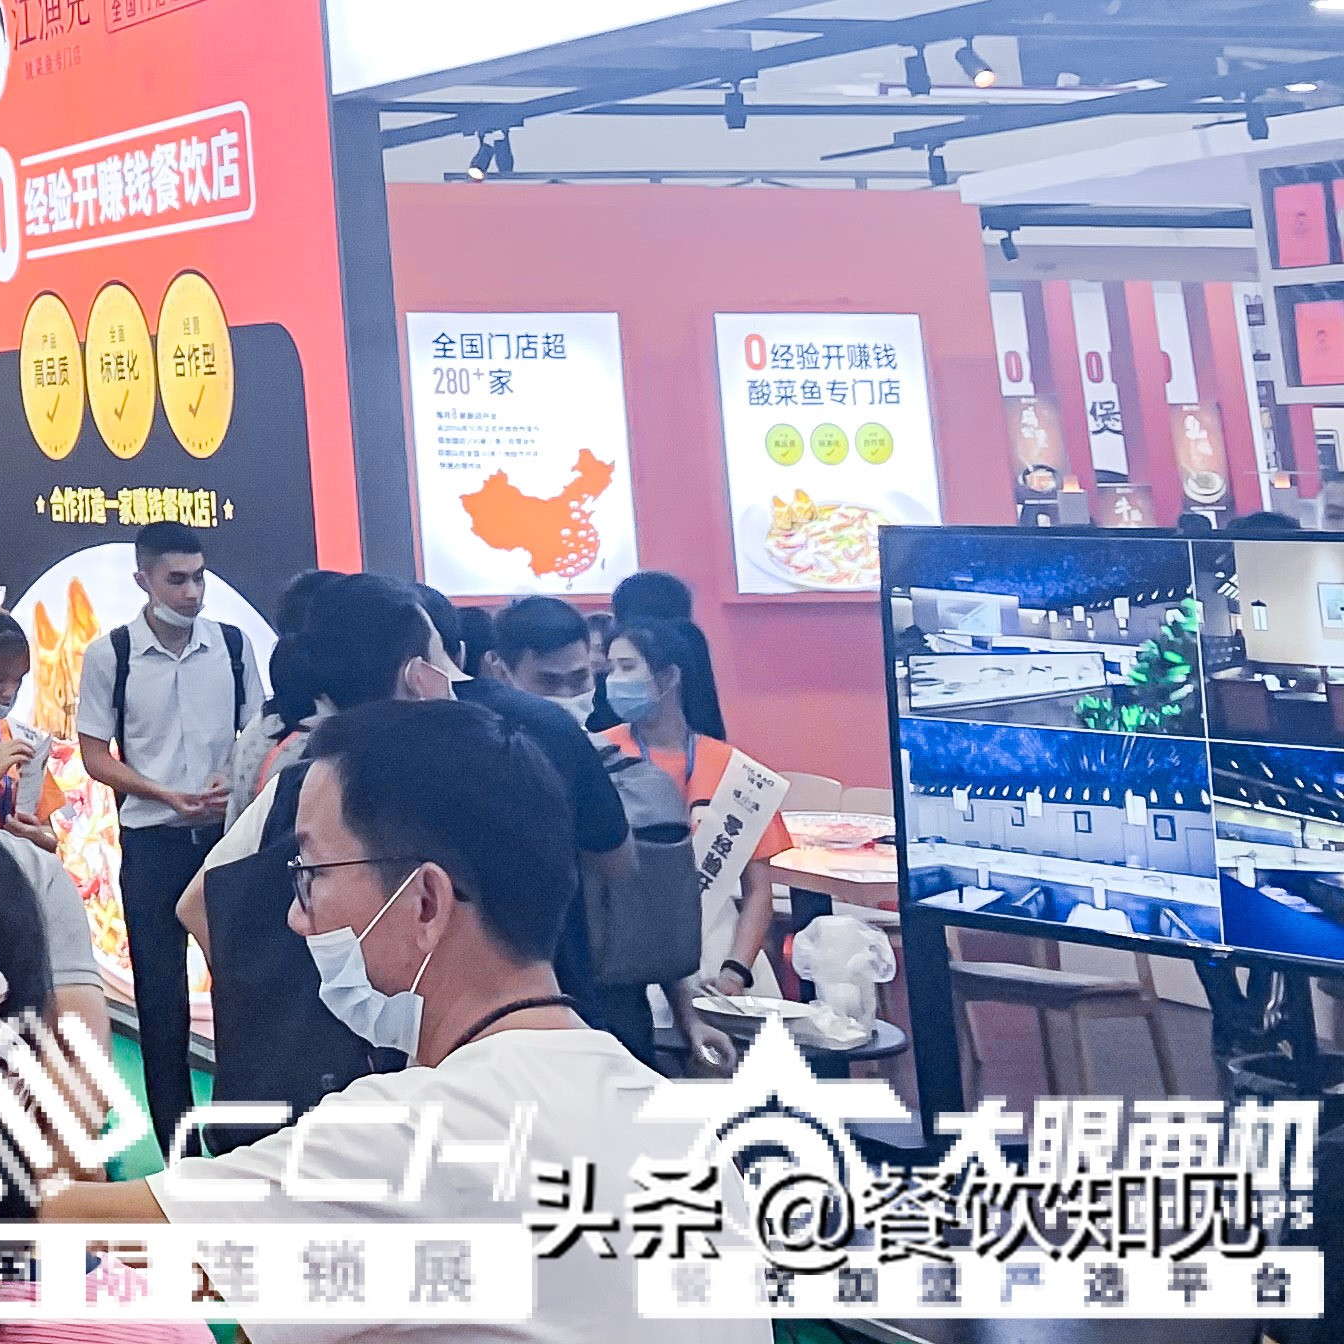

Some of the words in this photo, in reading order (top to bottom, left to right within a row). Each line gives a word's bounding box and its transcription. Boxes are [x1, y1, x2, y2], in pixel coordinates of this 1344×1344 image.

[173, 342, 217, 377] 合作型
[431, 332, 567, 360] 全国门店超
[746, 379, 902, 406] 酸菜鱼专门店
